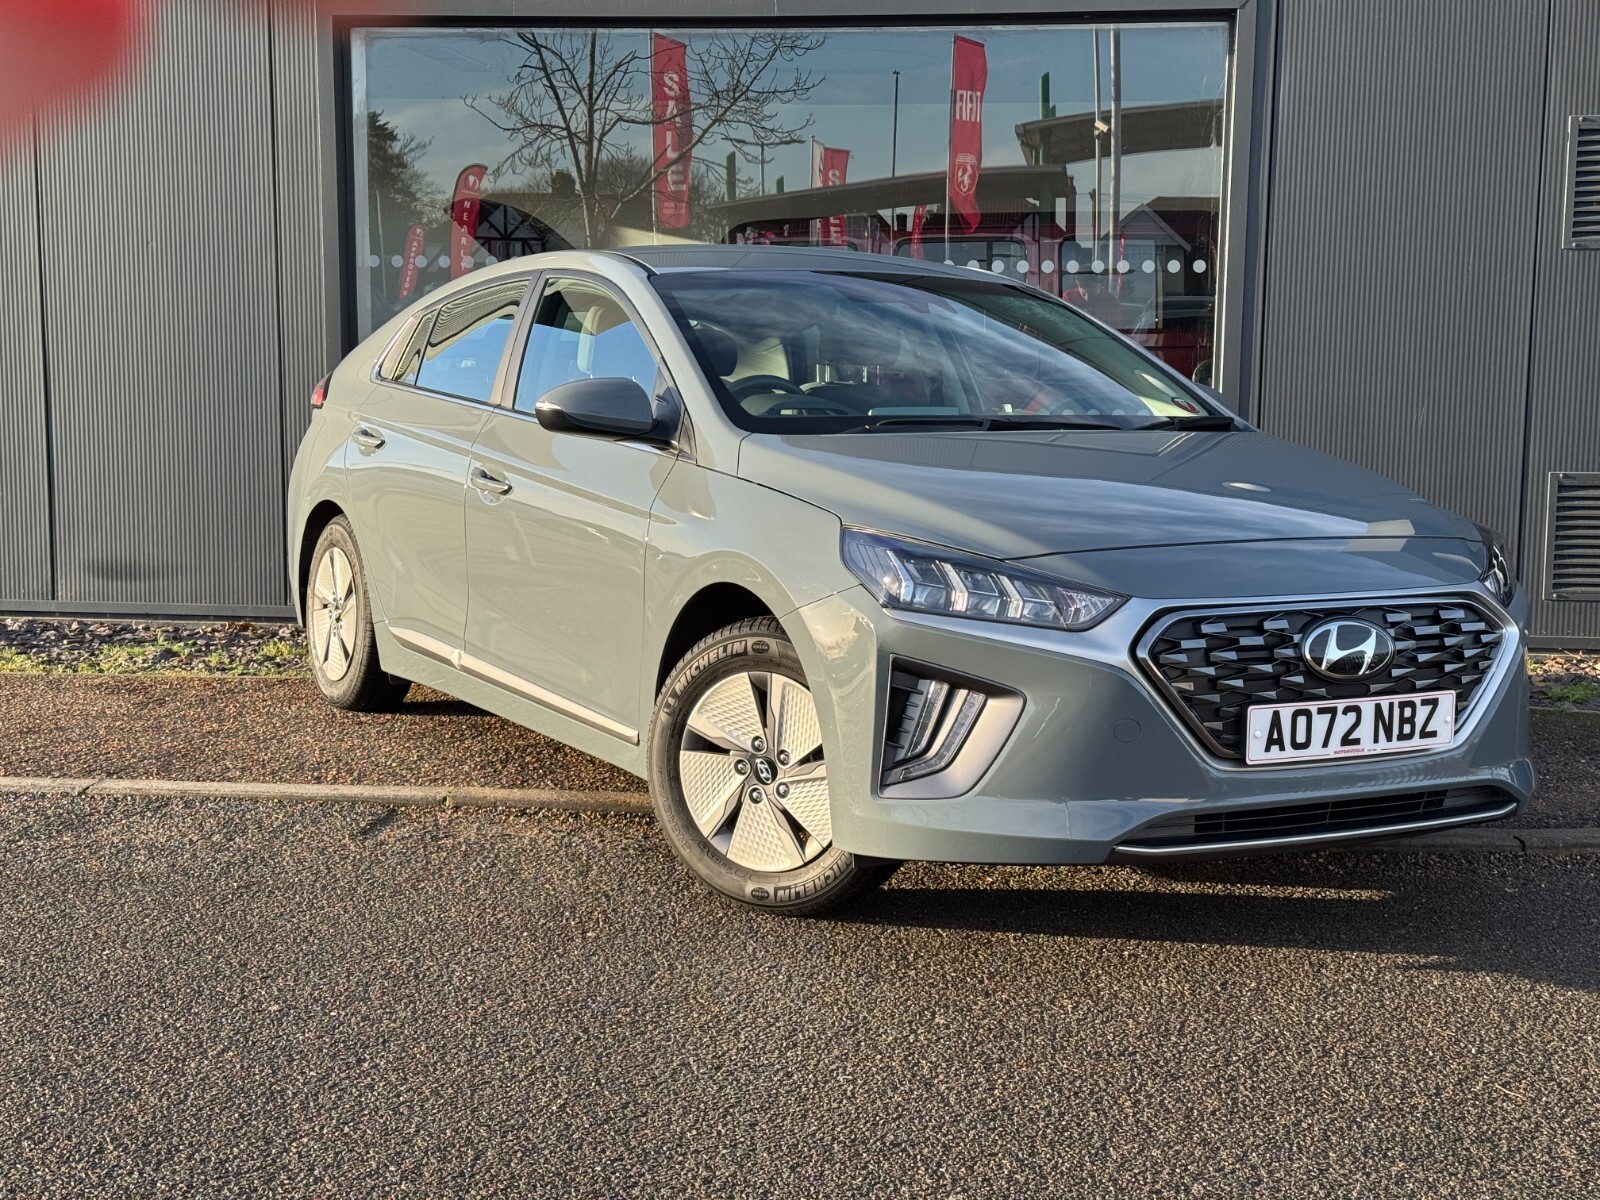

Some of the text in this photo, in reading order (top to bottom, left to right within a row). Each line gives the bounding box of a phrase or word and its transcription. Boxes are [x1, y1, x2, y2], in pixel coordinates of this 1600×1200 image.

[663, 71, 686, 191] SALE
[955, 89, 982, 123] FIAT
[460, 200, 471, 271] NEARLY
[404, 240, 418, 288] APPROVED
[674, 640, 748, 696] MICHELIN
[1373, 697, 1440, 744] NBZ
[776, 851, 853, 902] MICHELIN
